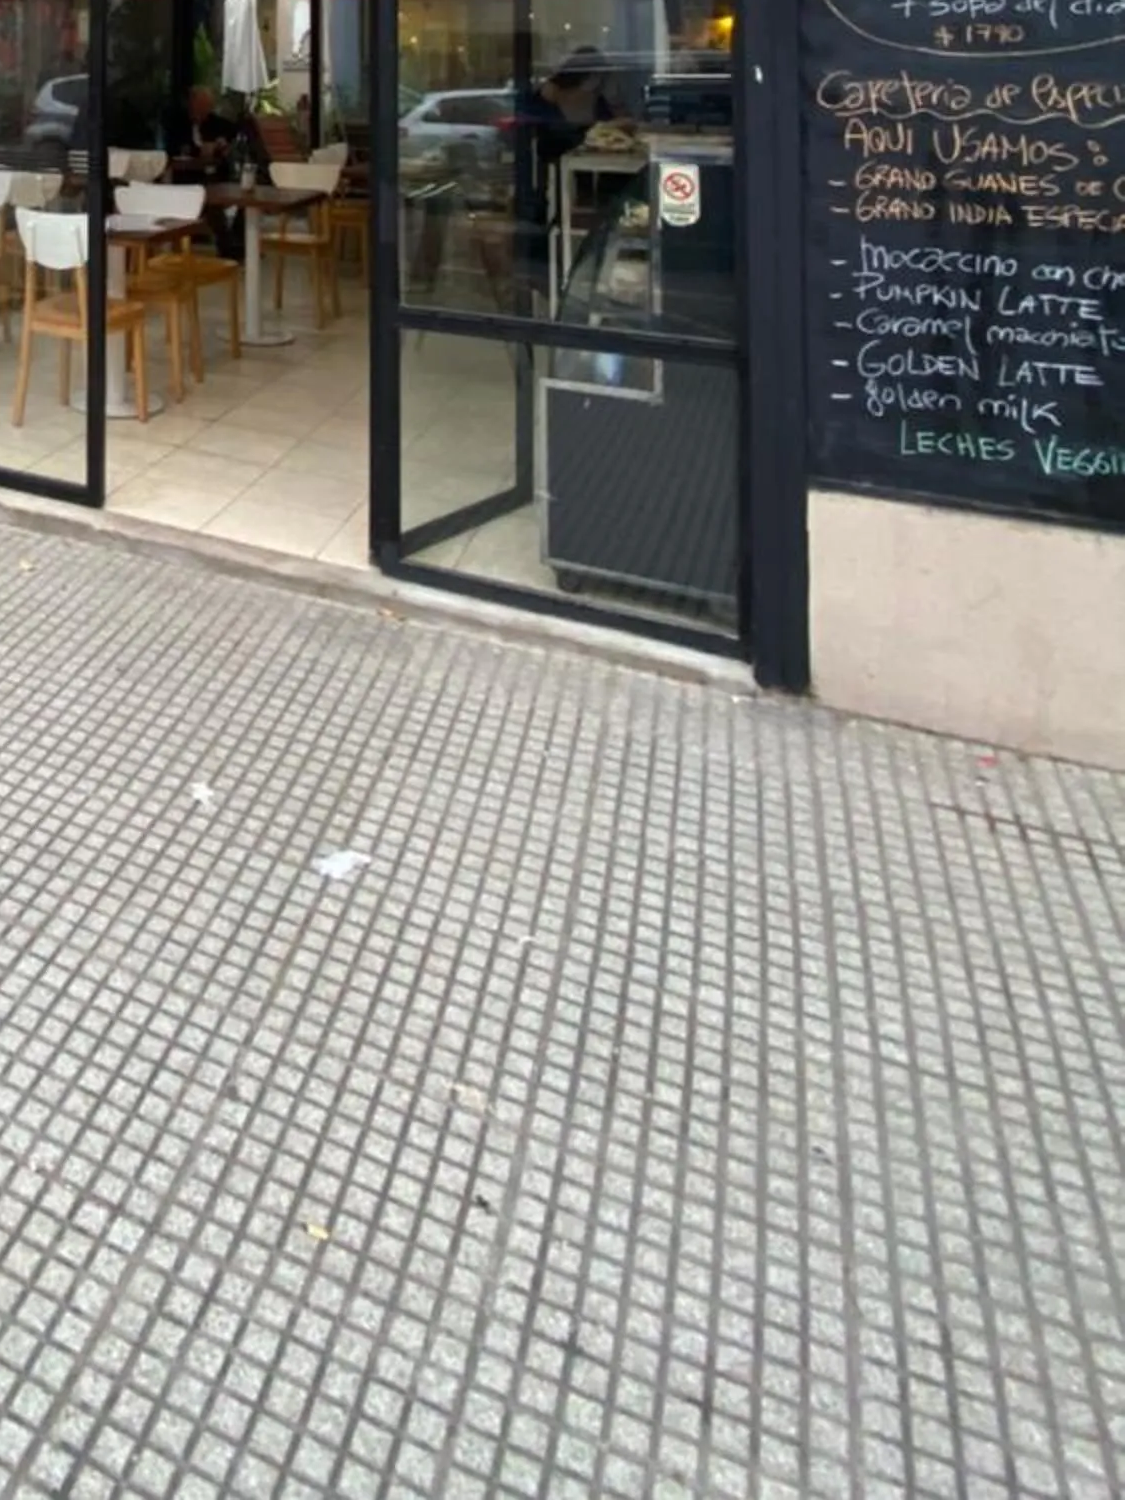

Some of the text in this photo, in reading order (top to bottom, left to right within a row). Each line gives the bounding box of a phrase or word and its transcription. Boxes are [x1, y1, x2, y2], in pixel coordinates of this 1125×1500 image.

[985, 83, 1022, 109] de
[949, 201, 1013, 226] INDIA
[997, 285, 1104, 321] LATTE
[857, 341, 1104, 387] GOLDEN LATTE
[900, 419, 1016, 461] LECHES
